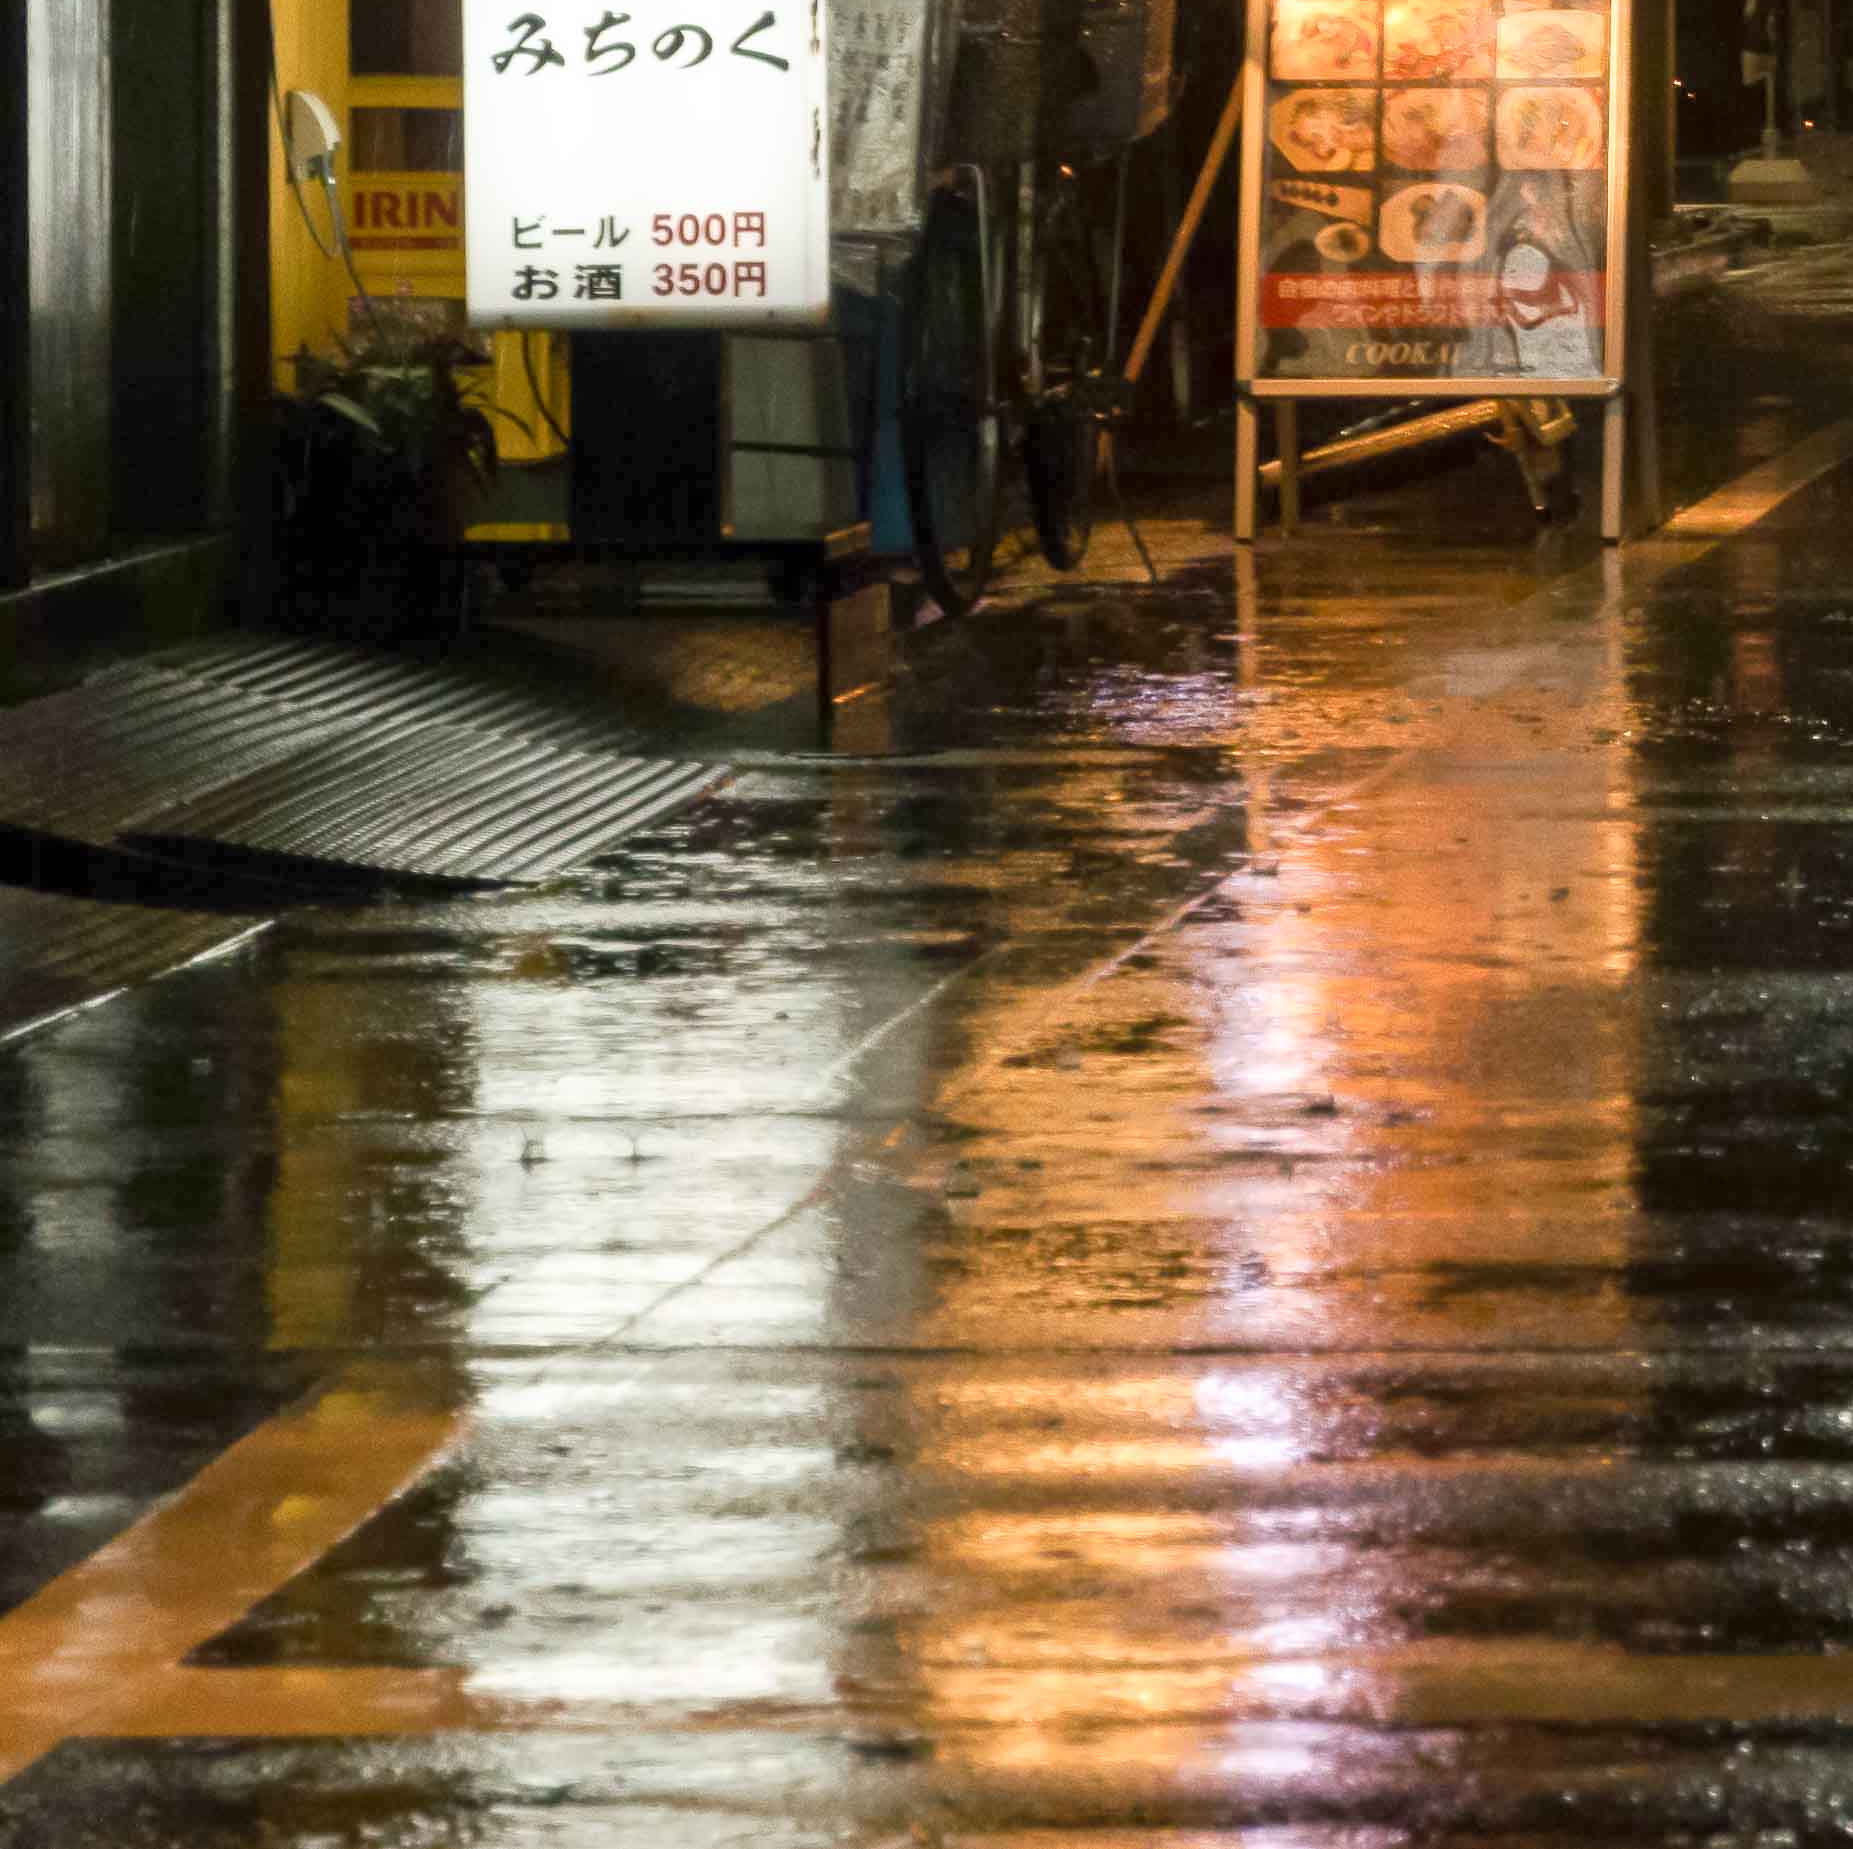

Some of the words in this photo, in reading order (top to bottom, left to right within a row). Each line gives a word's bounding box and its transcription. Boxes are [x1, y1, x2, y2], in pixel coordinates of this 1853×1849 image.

[491, 9, 790, 77] みちのく
[354, 191, 458, 229] IRIN
[511, 215, 630, 250] ビール
[650, 211, 767, 249] 500円
[510, 263, 623, 301] お酒
[651, 261, 767, 298] 350円
